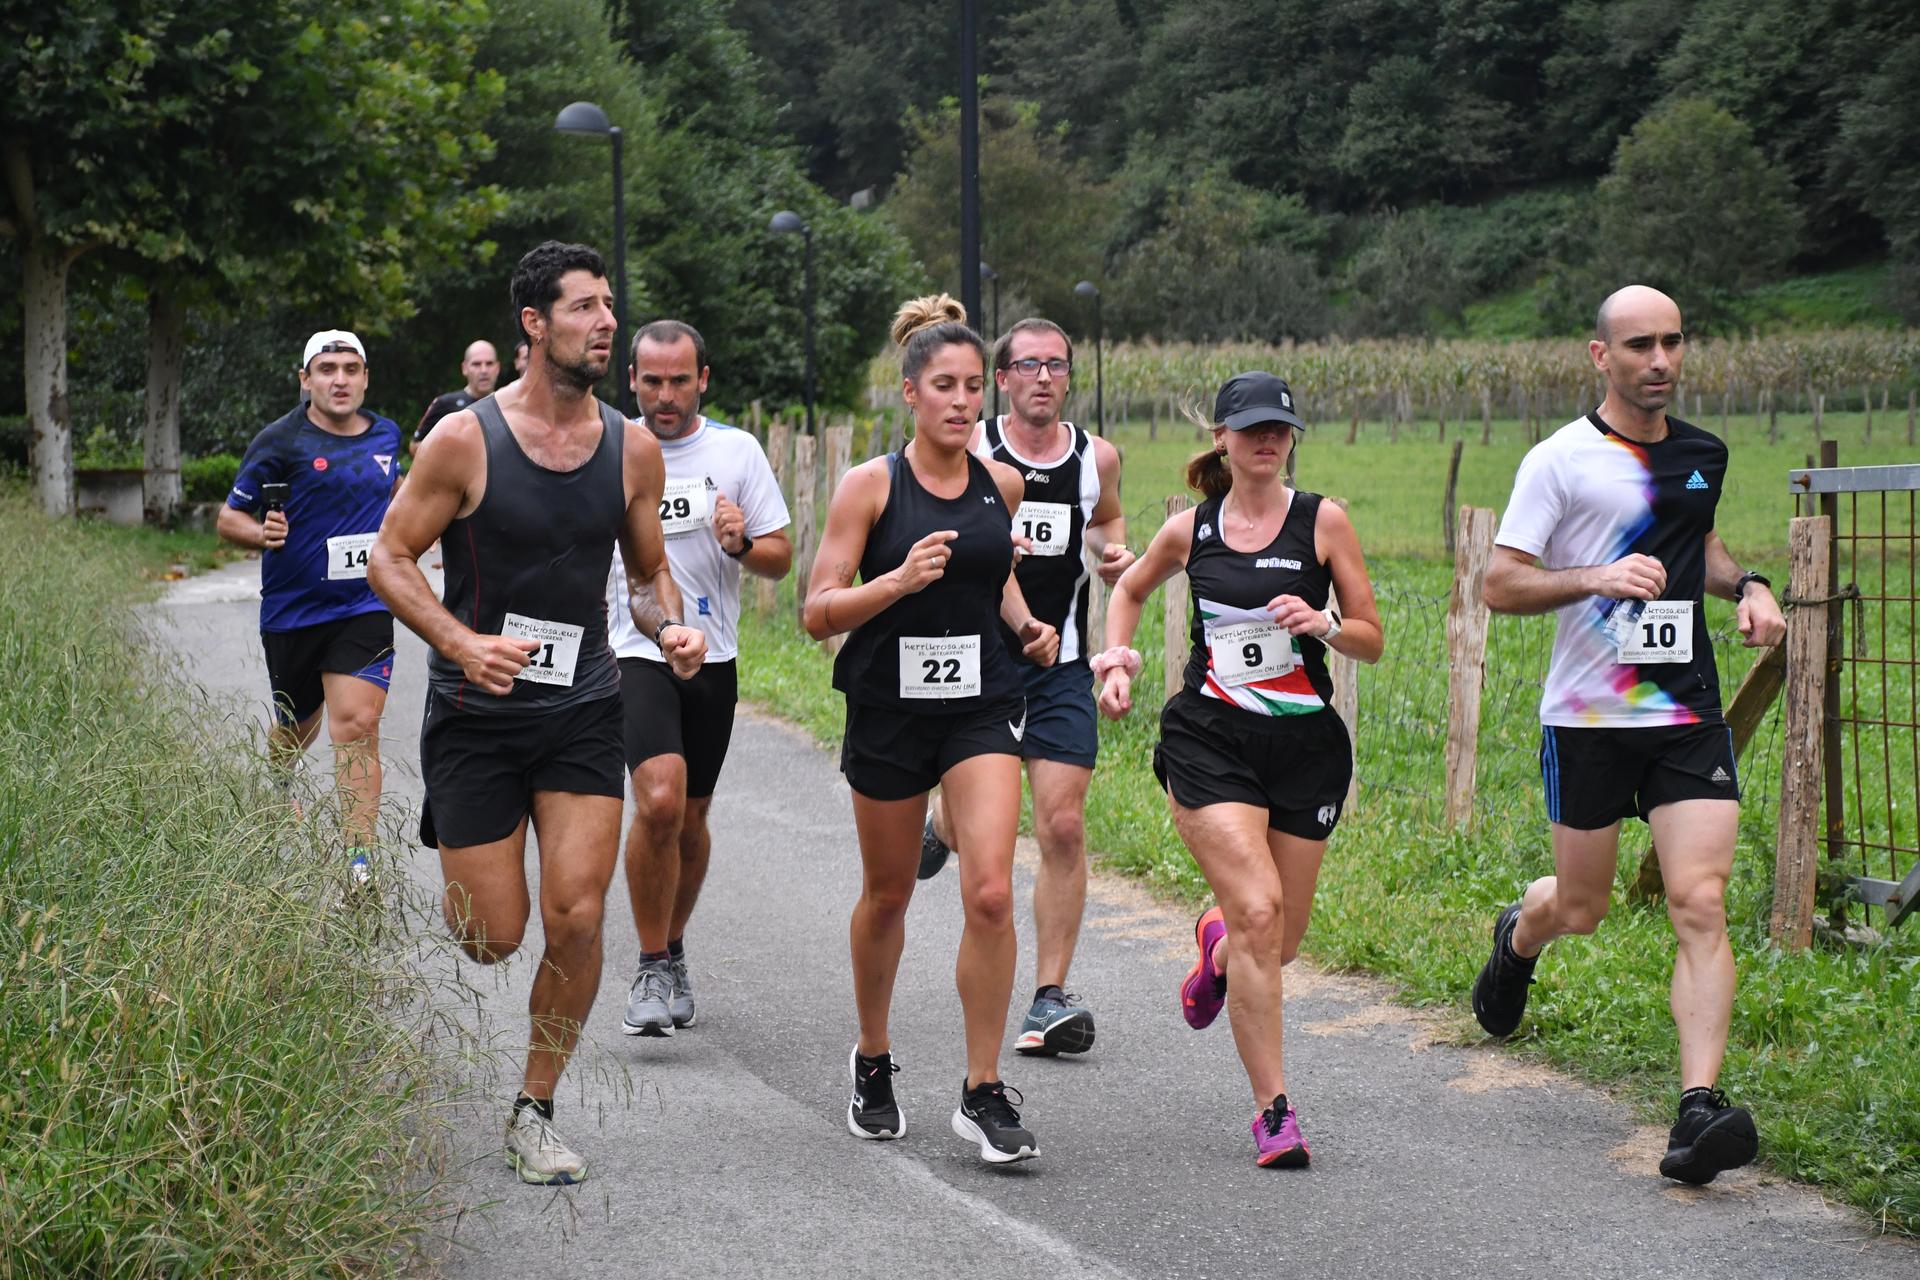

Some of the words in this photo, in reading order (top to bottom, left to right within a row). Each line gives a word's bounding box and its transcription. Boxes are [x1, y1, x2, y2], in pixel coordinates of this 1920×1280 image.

[660, 498, 691, 521] 29
[1022, 521, 1052, 543] 16
[345, 550, 368, 568] 14
[1214, 626, 1280, 641] herrikrosa.eu
[1642, 622, 1676, 649] 10
[904, 641, 976, 651] herrikrosa.eus
[1242, 643, 1264, 668] 9
[922, 658, 962, 684] 22
